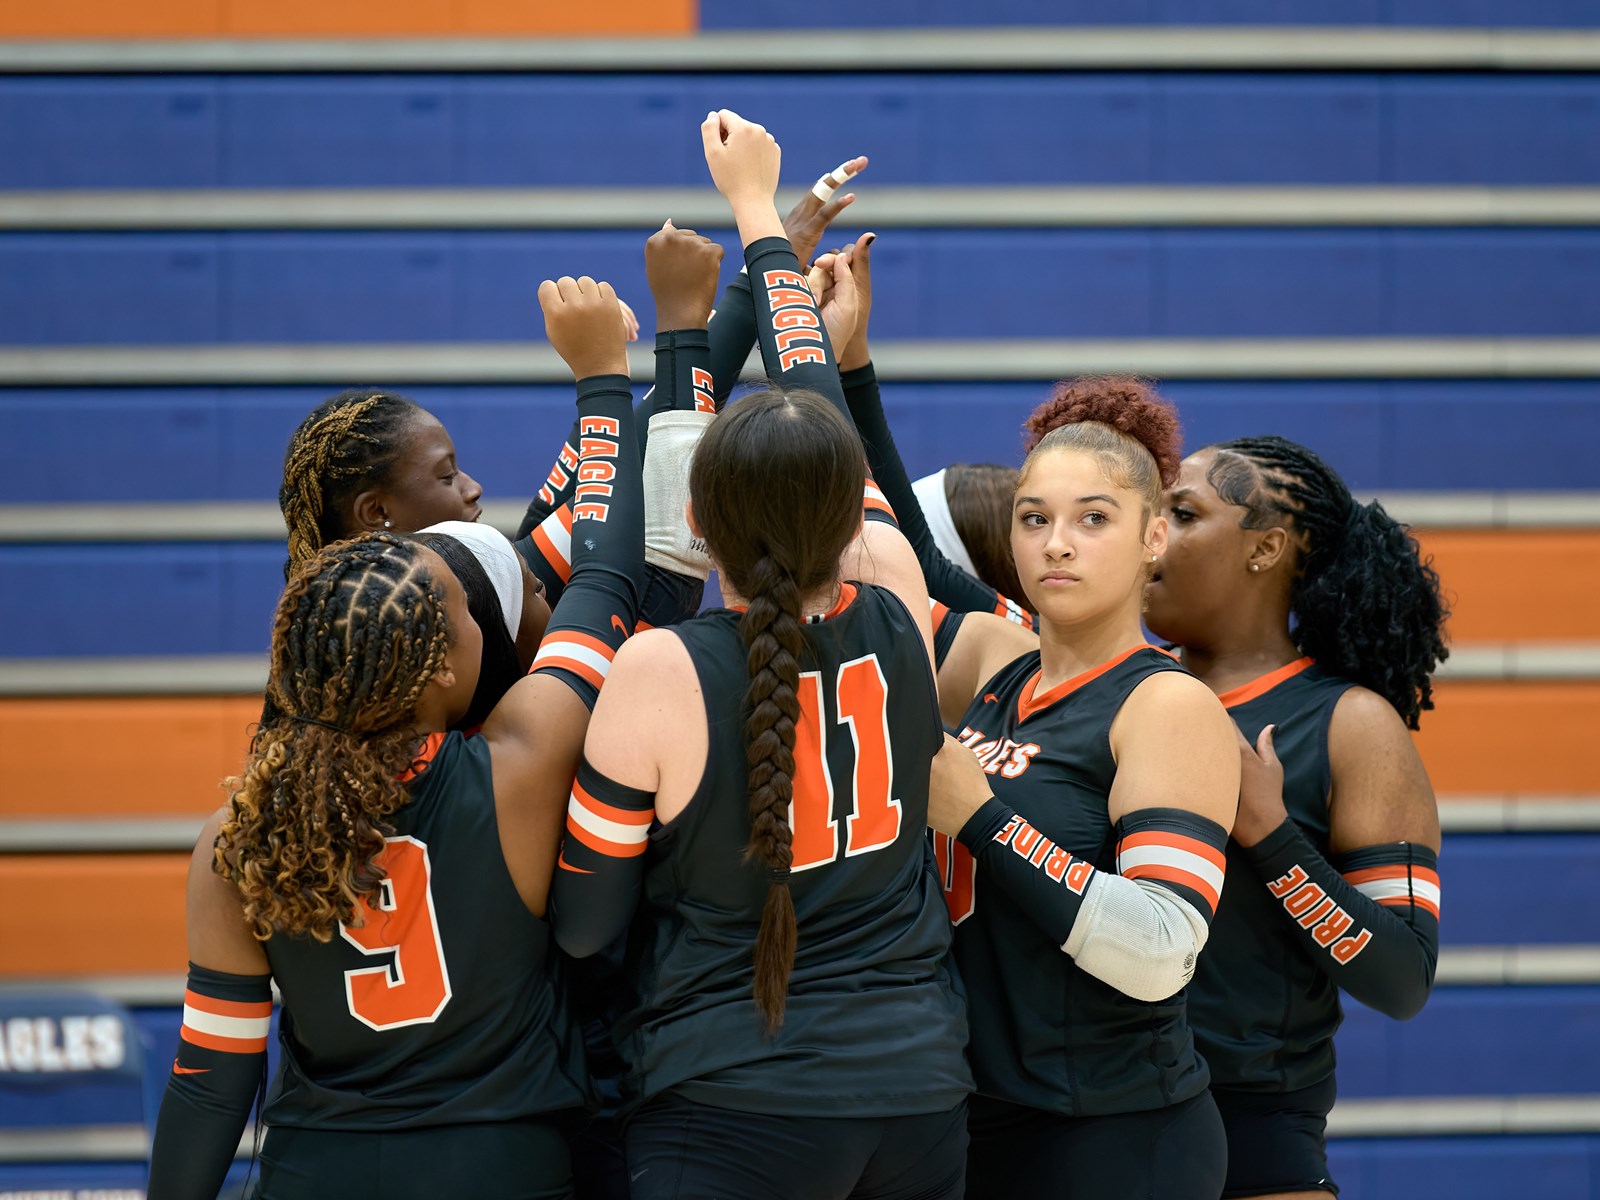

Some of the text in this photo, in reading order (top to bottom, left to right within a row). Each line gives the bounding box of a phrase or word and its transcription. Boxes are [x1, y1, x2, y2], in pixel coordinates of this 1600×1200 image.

[763, 269, 827, 372] EAGLE
[572, 415, 620, 523] EAGLE
[789, 653, 903, 873] 11
[992, 814, 1095, 896] PRIDE
[338, 835, 453, 1032] 9
[1266, 863, 1373, 966] PRIDE
